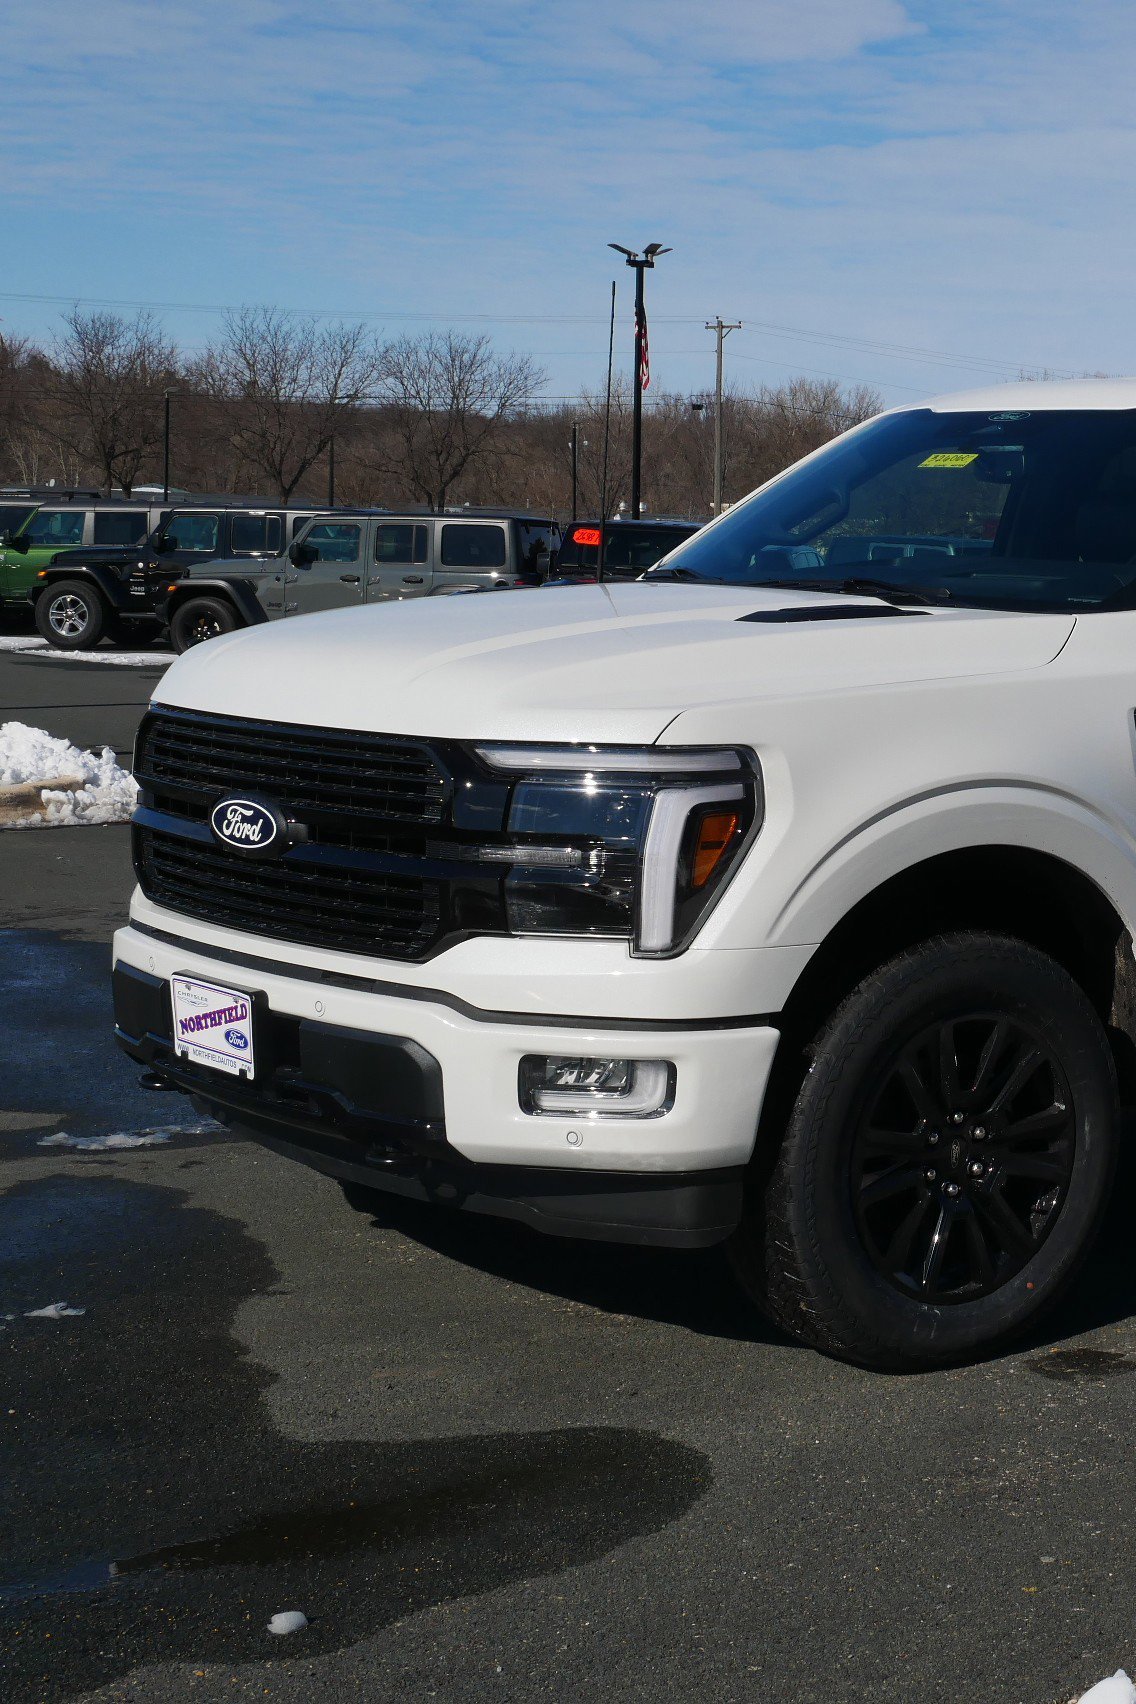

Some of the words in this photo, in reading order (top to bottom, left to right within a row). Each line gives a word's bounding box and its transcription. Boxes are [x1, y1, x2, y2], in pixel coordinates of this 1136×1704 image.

[223, 806, 263, 842] Ford
[179, 1003, 248, 1035] NORTHFIELD
[228, 1031, 245, 1047] Ford
